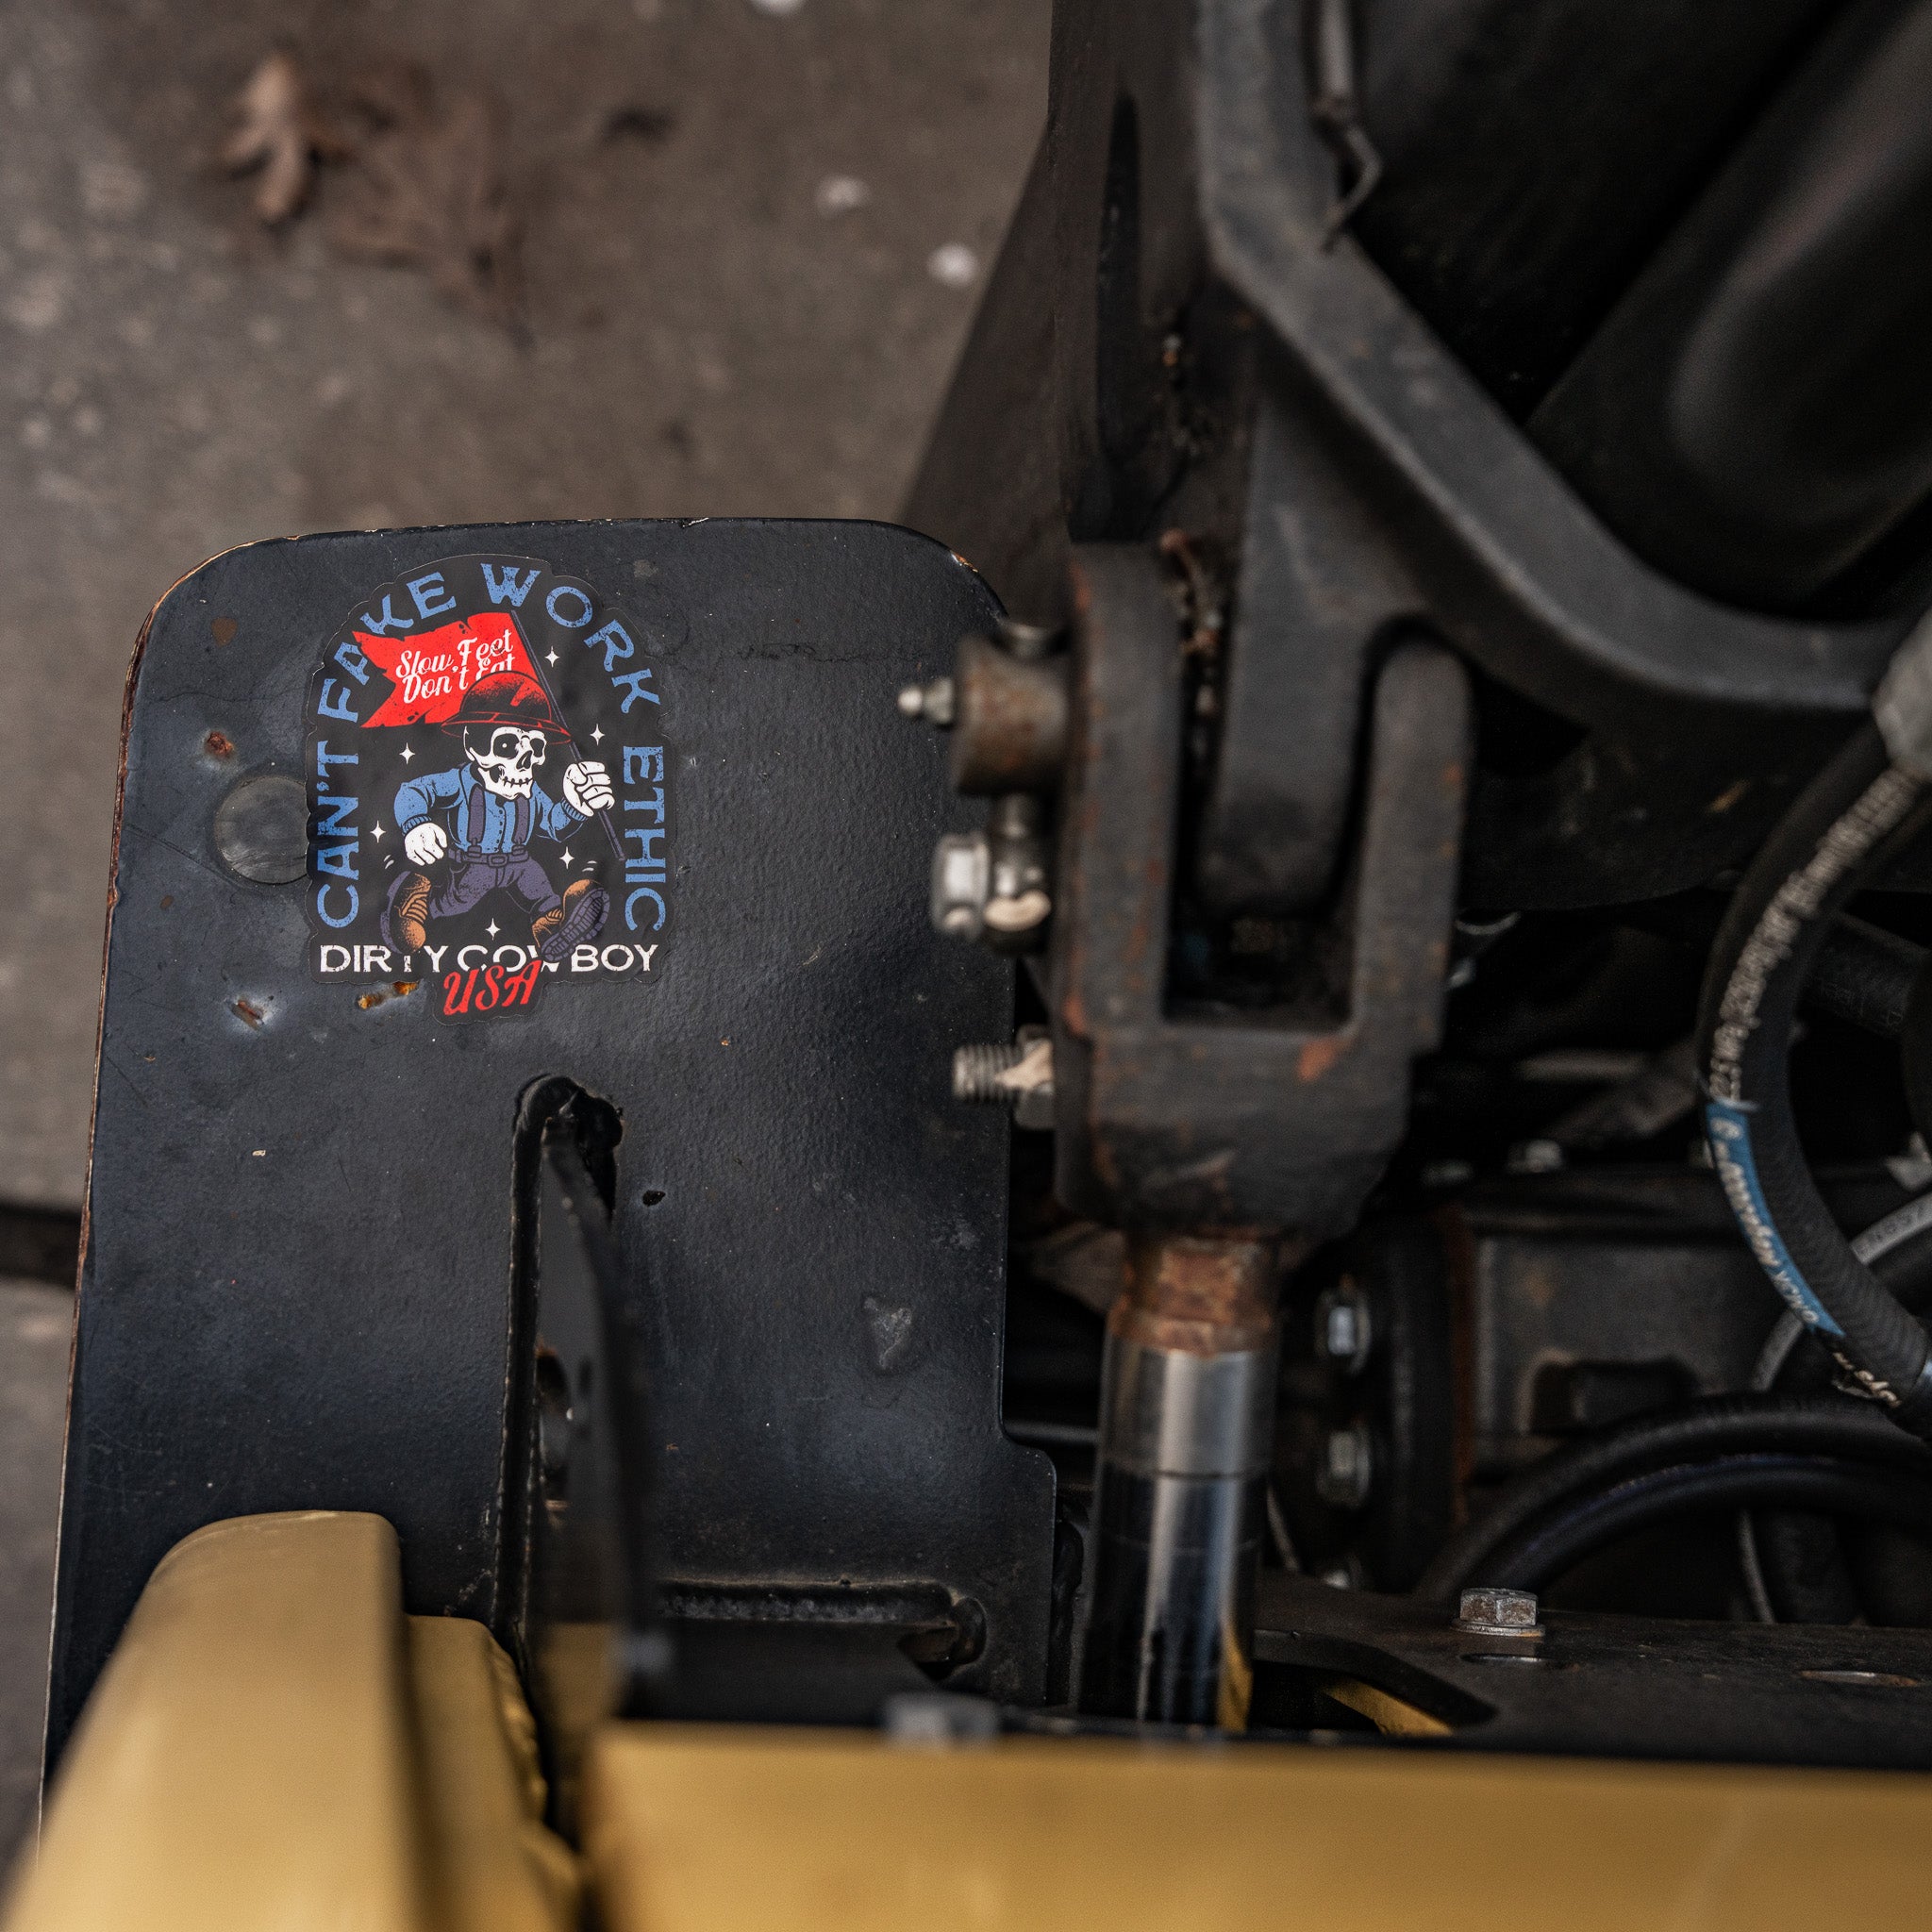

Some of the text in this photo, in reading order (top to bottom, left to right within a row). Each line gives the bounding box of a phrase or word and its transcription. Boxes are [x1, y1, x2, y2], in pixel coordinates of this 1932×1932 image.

[395, 628, 514, 678] Slow Feet
[402, 664, 469, 704] Don't
[317, 563, 666, 932] CAN'T FAKE WORK ETHIC
[442, 959, 542, 1016] USA
